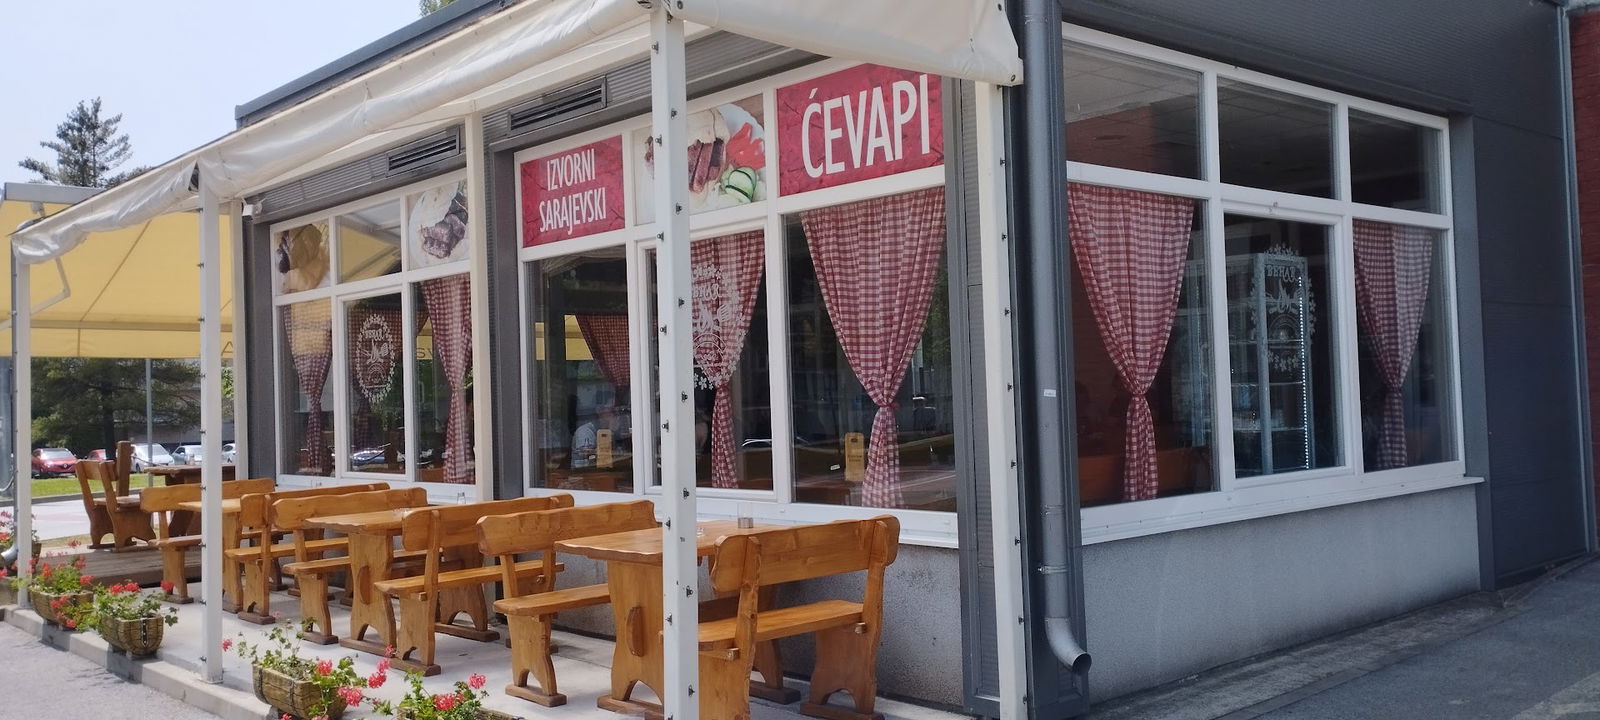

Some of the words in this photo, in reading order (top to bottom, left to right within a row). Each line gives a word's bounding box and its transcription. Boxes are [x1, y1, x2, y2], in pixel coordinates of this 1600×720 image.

[802, 74, 930, 178] ĆEVAPI
[546, 148, 596, 191] IZVORNI
[538, 186, 607, 236] SARAJEVSKI
